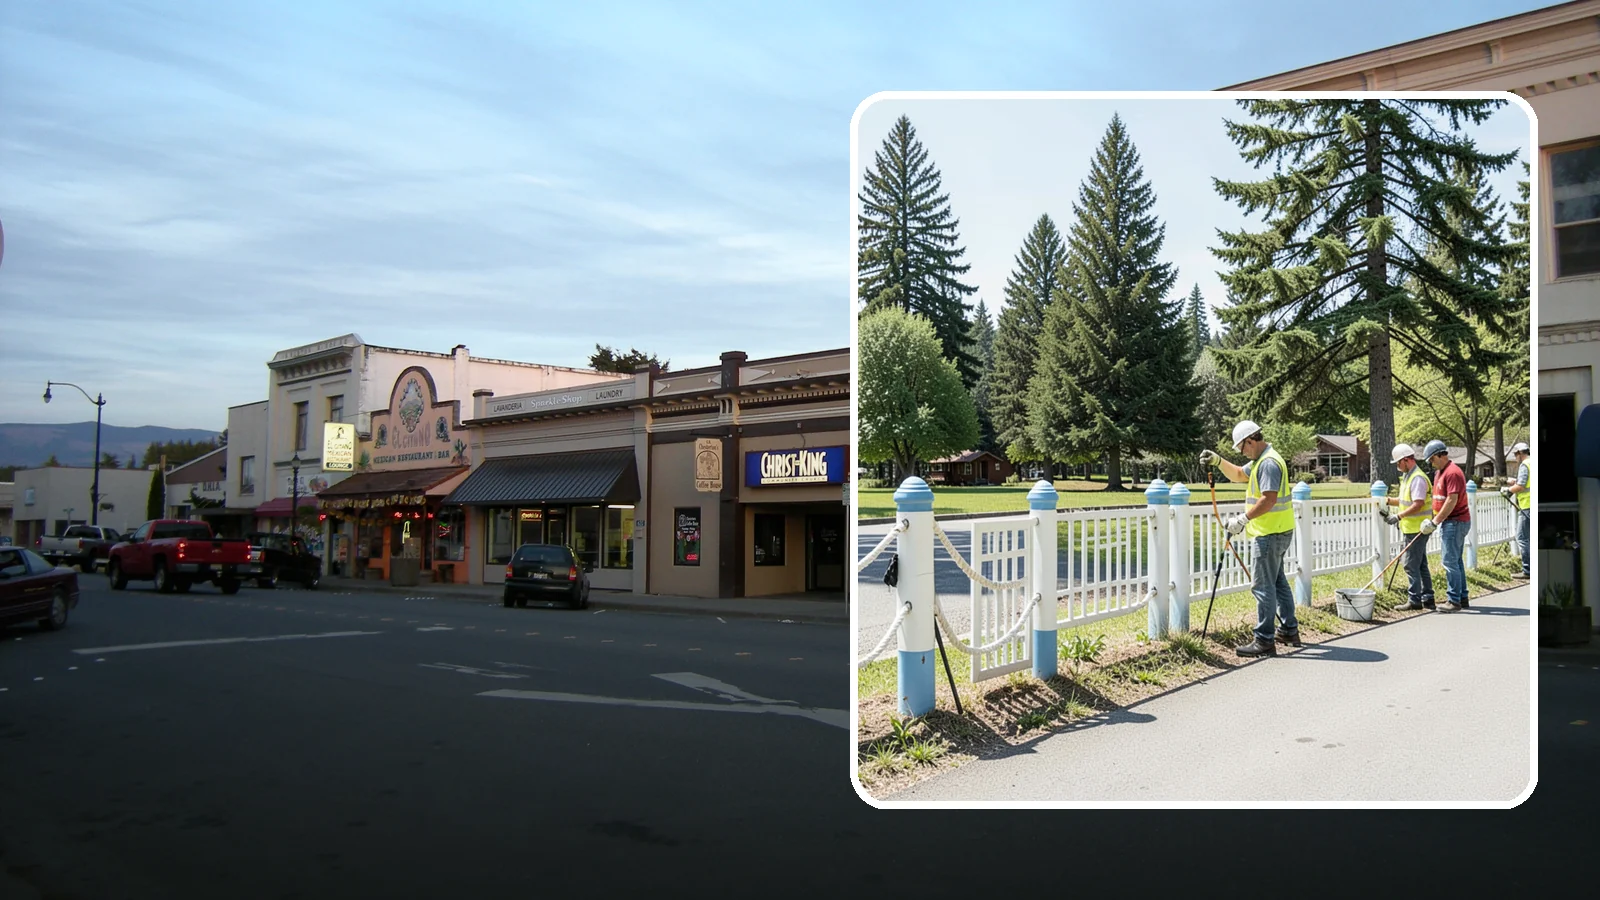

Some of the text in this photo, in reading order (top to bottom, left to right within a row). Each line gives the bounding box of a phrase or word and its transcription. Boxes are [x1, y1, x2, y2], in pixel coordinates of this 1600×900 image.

[595, 389, 623, 400] LAUNDRY
[494, 402, 522, 412] LAVANDERIA
[531, 394, 582, 409] Sparkle Shop
[373, 455, 396, 464] MEXICAN
[397, 451, 433, 462] RESTAURANT
[437, 450, 450, 459] BAR
[696, 480, 709, 488] Coffee
